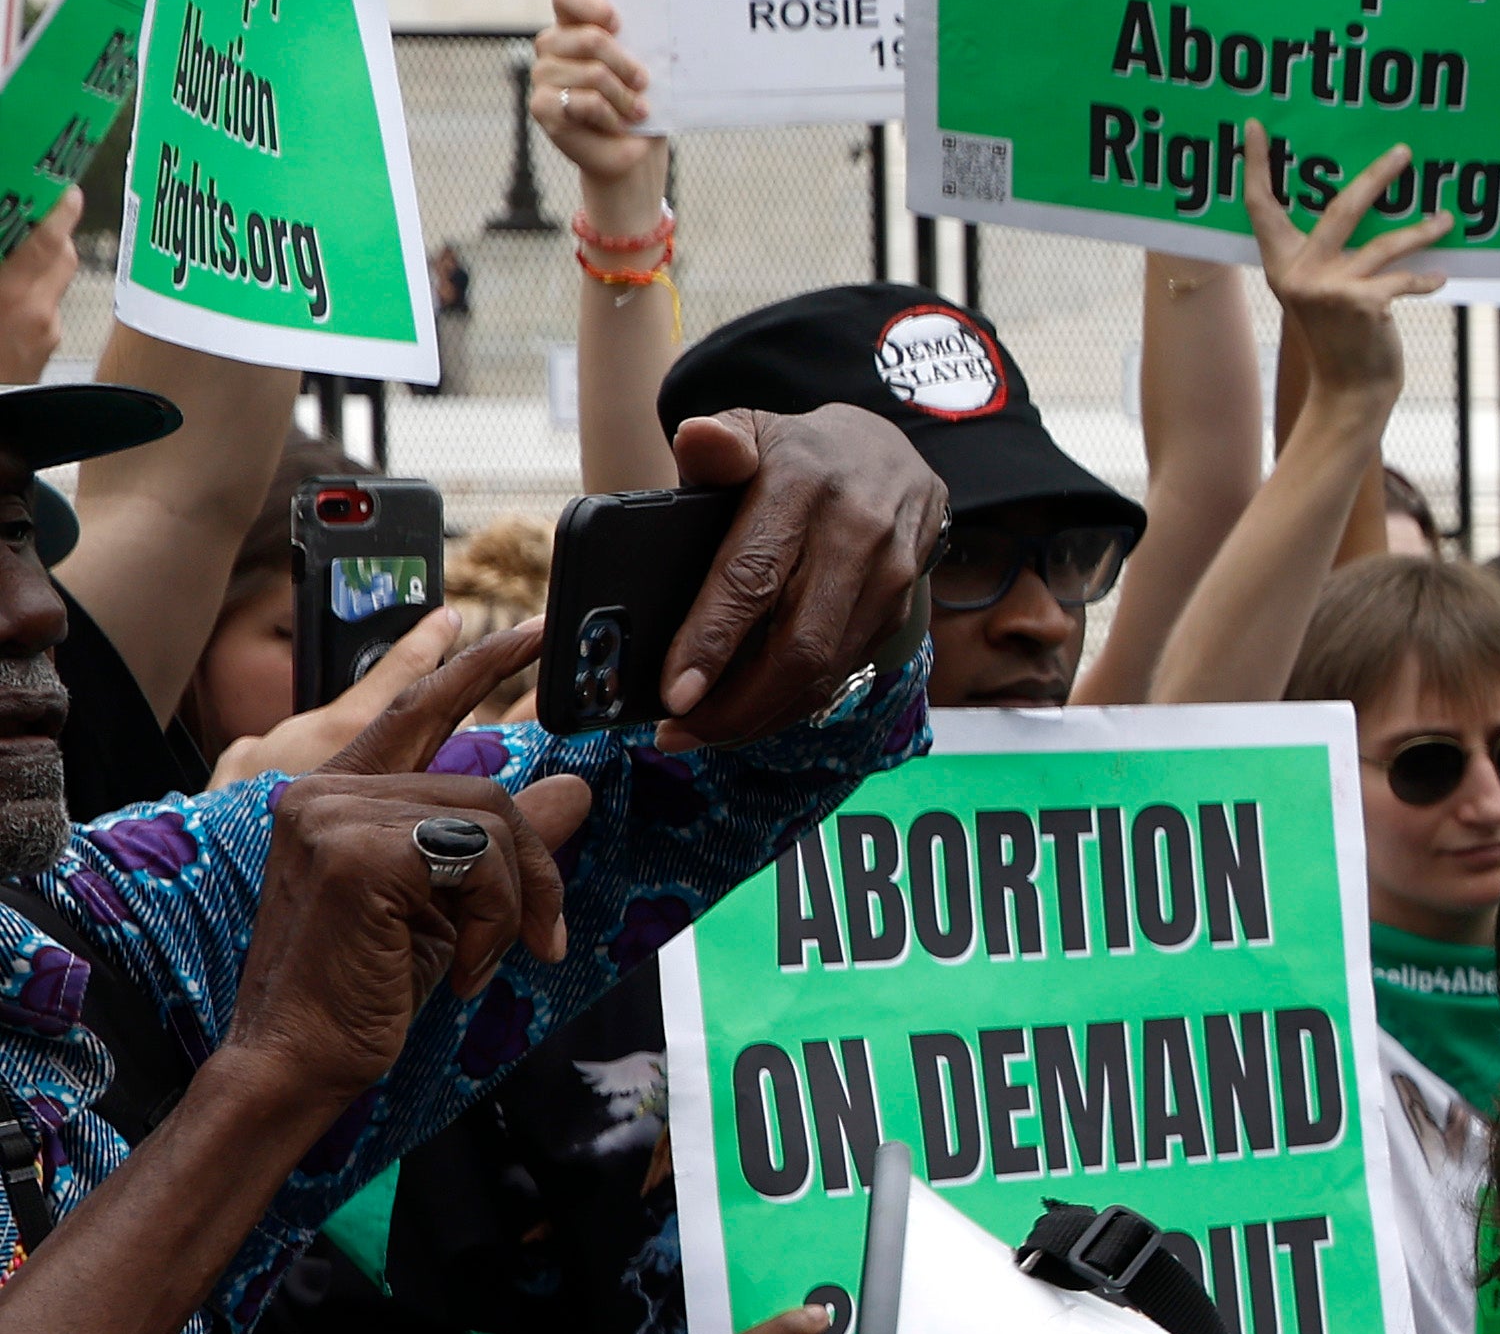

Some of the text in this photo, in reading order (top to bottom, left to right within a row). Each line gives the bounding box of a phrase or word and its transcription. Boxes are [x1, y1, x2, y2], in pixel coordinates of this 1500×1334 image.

[173, 0, 281, 158] Abortion
[151, 142, 331, 323] Rights.org
[881, 328, 987, 368] DEMON
[886, 357, 998, 402] SLAYER
[776, 801, 1274, 975] ABORTION
[733, 1006, 1348, 1203] ON DEMAND
